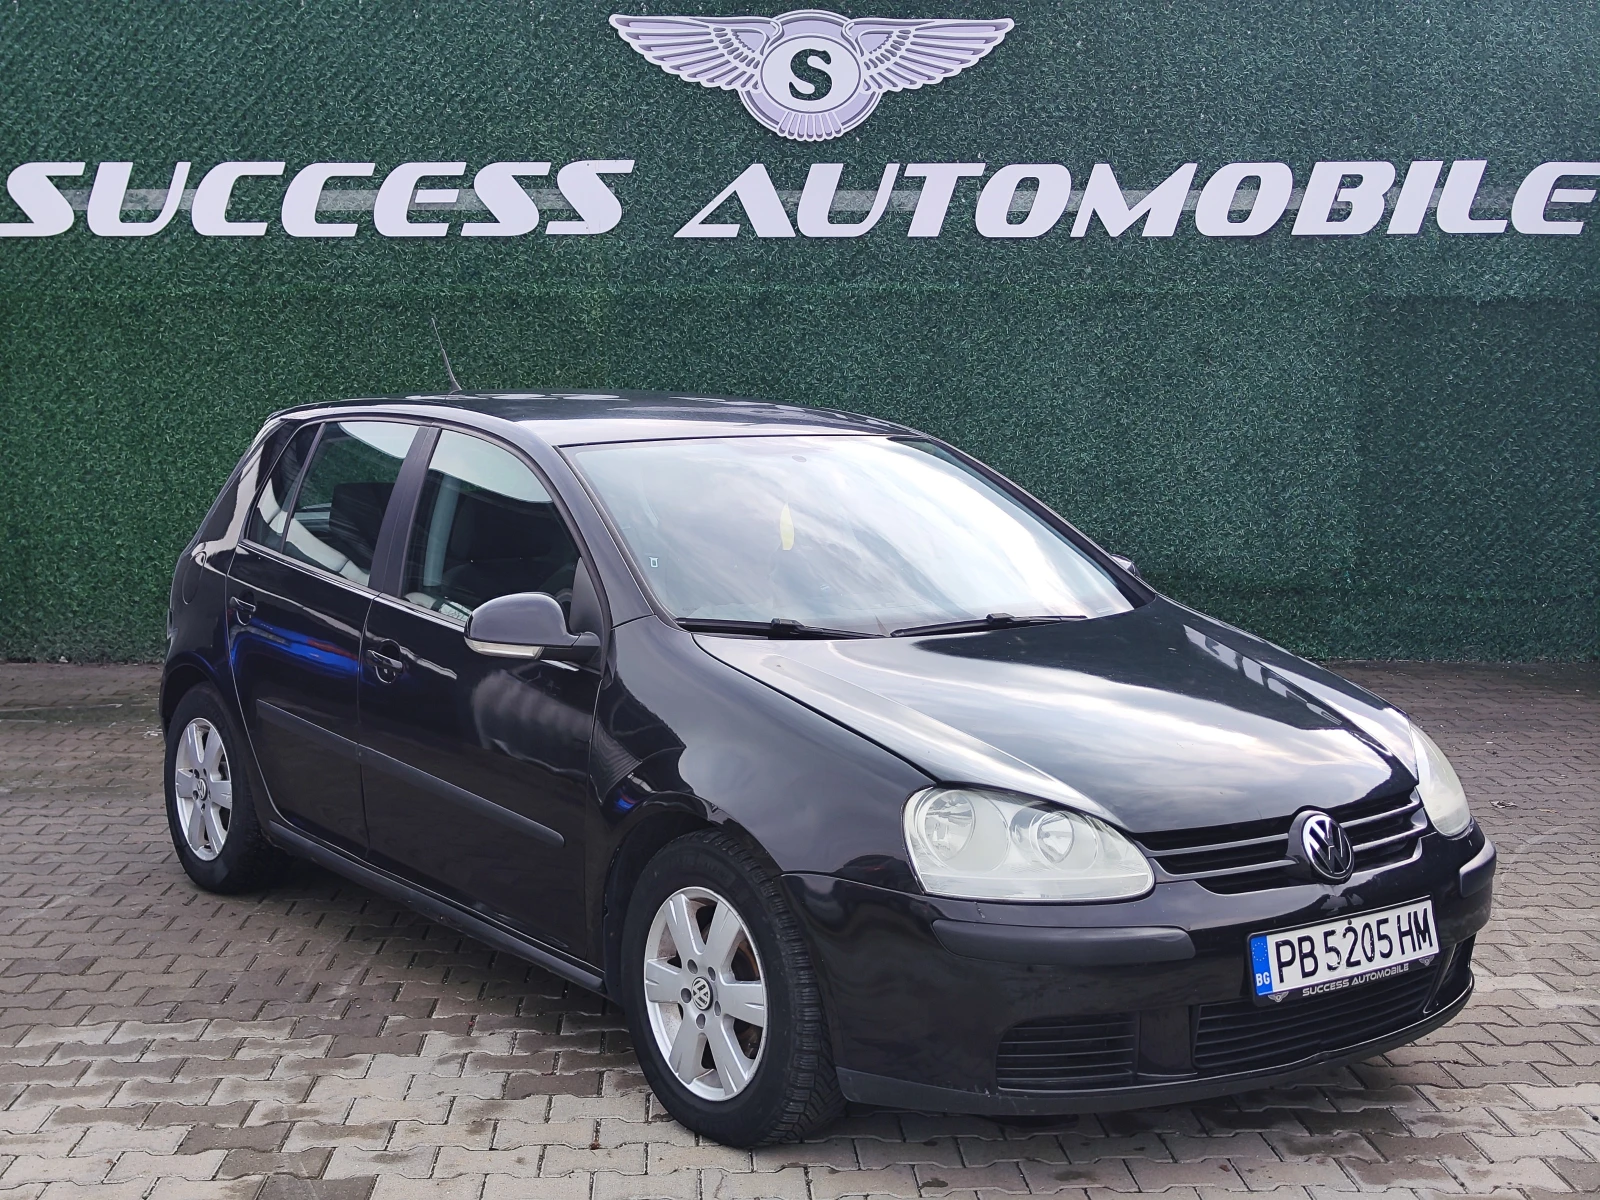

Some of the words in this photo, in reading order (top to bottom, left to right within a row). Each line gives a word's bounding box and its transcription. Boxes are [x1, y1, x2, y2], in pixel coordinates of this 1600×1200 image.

[788, 48, 834, 101] S
[0, 159, 635, 238] SUCCESS
[674, 159, 1600, 238] AUTOMOBILE
[1255, 971, 1272, 987] BG
[1302, 978, 1350, 997] SUCCESS
[1351, 962, 1410, 986] AUTOMOBILE
